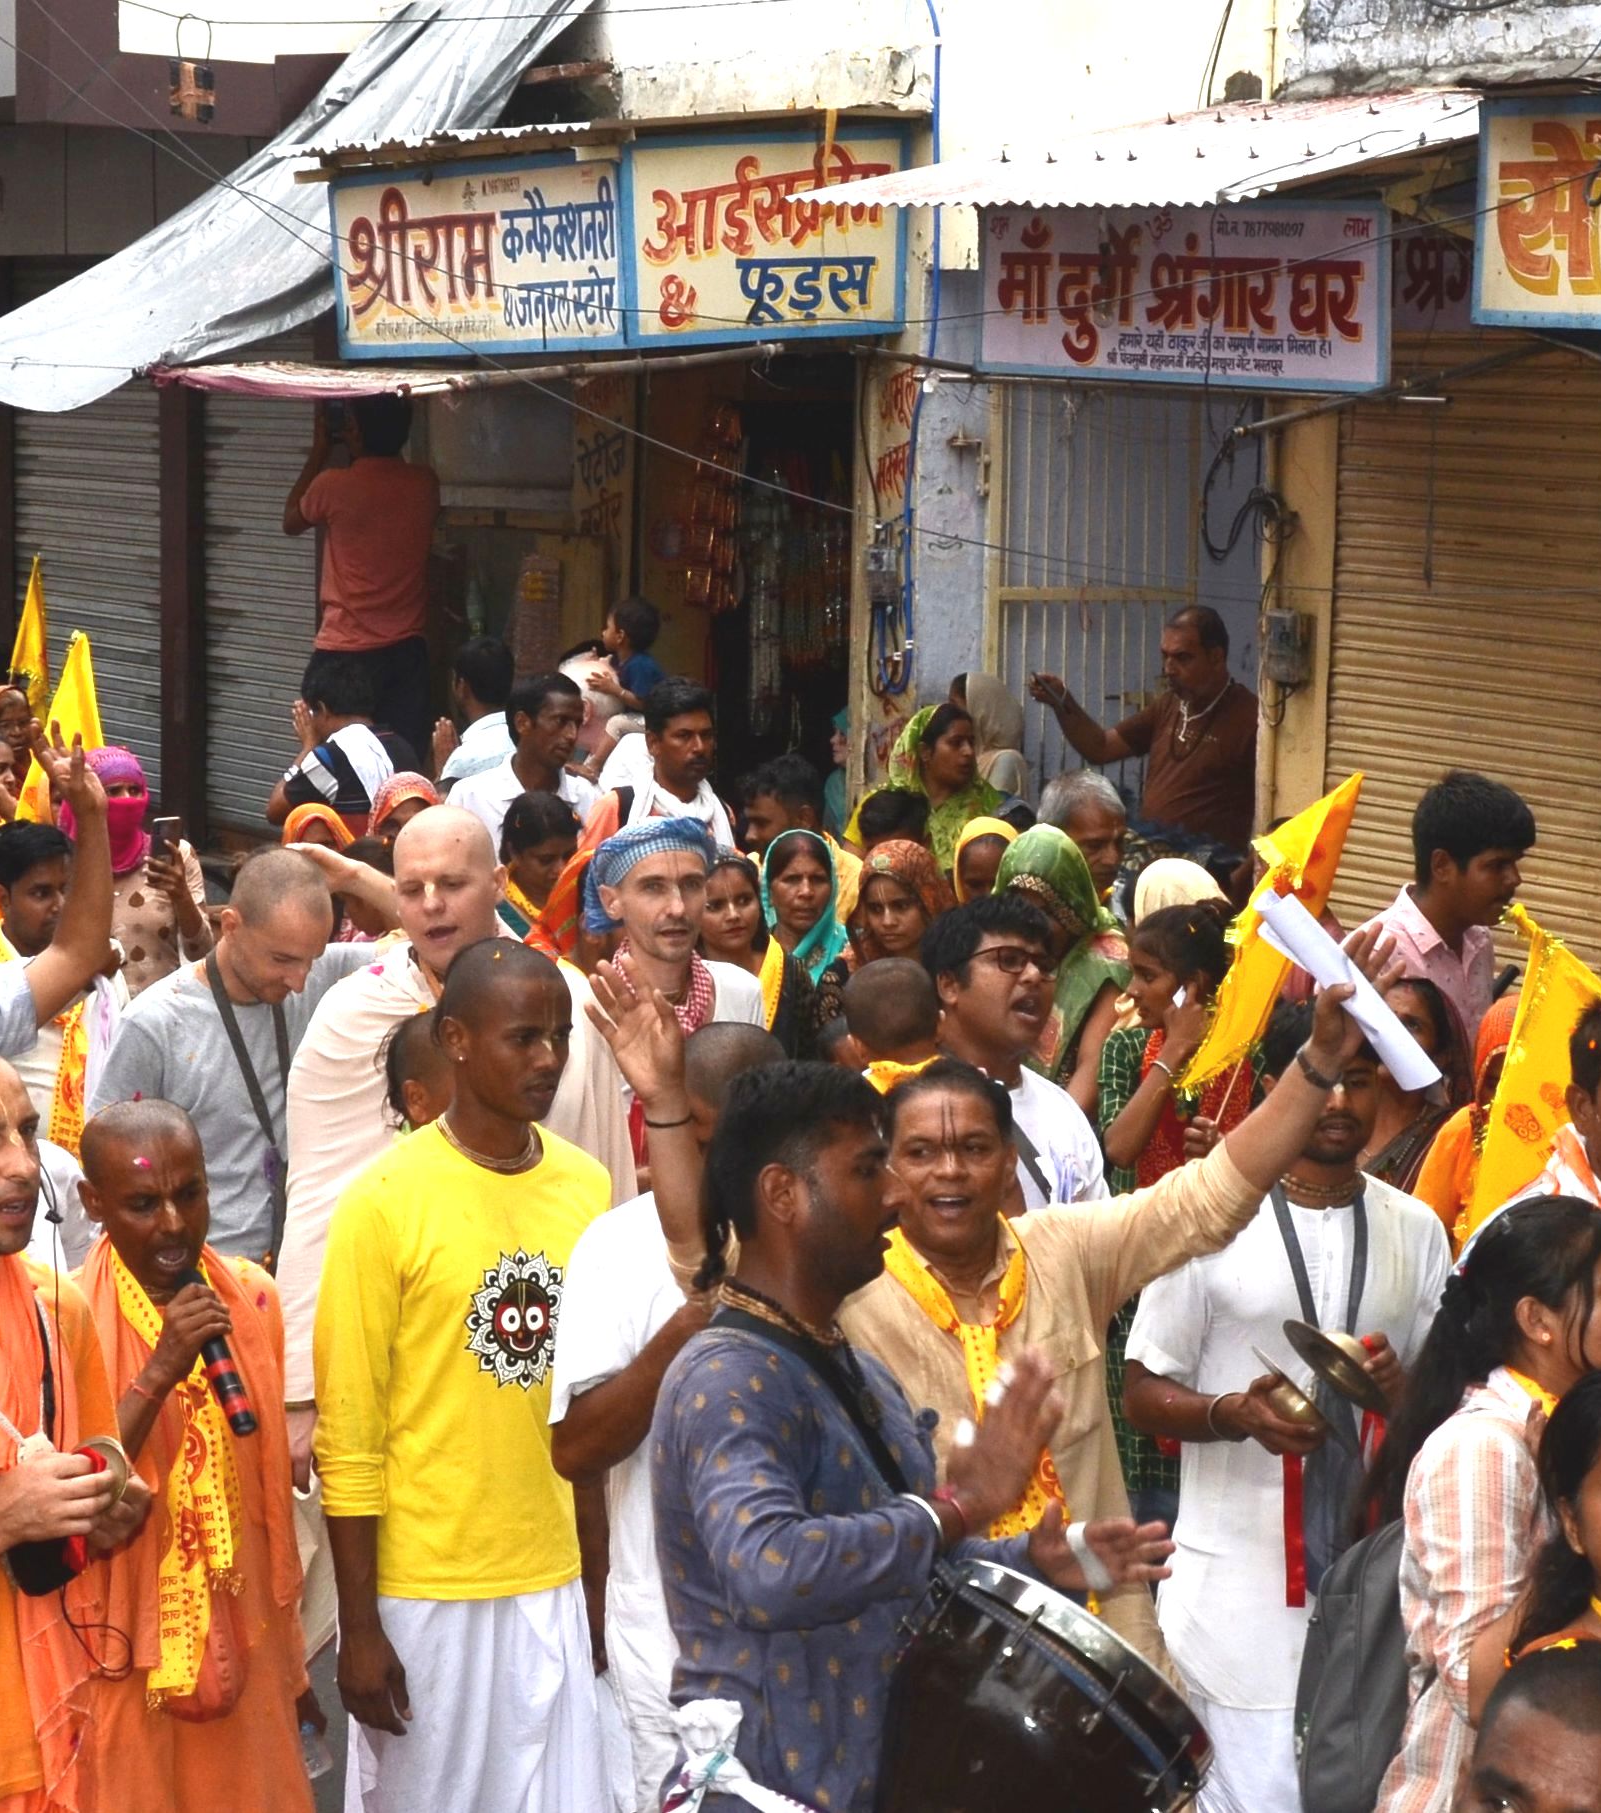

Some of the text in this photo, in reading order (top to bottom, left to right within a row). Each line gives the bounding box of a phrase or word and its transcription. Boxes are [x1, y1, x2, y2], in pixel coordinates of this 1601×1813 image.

[347, 186, 497, 316] श्रीराम
[572, 264, 616, 333] स्टोर
[998, 216, 1054, 326] माँ
[1288, 258, 1365, 344] घर
[659, 274, 697, 329] &
